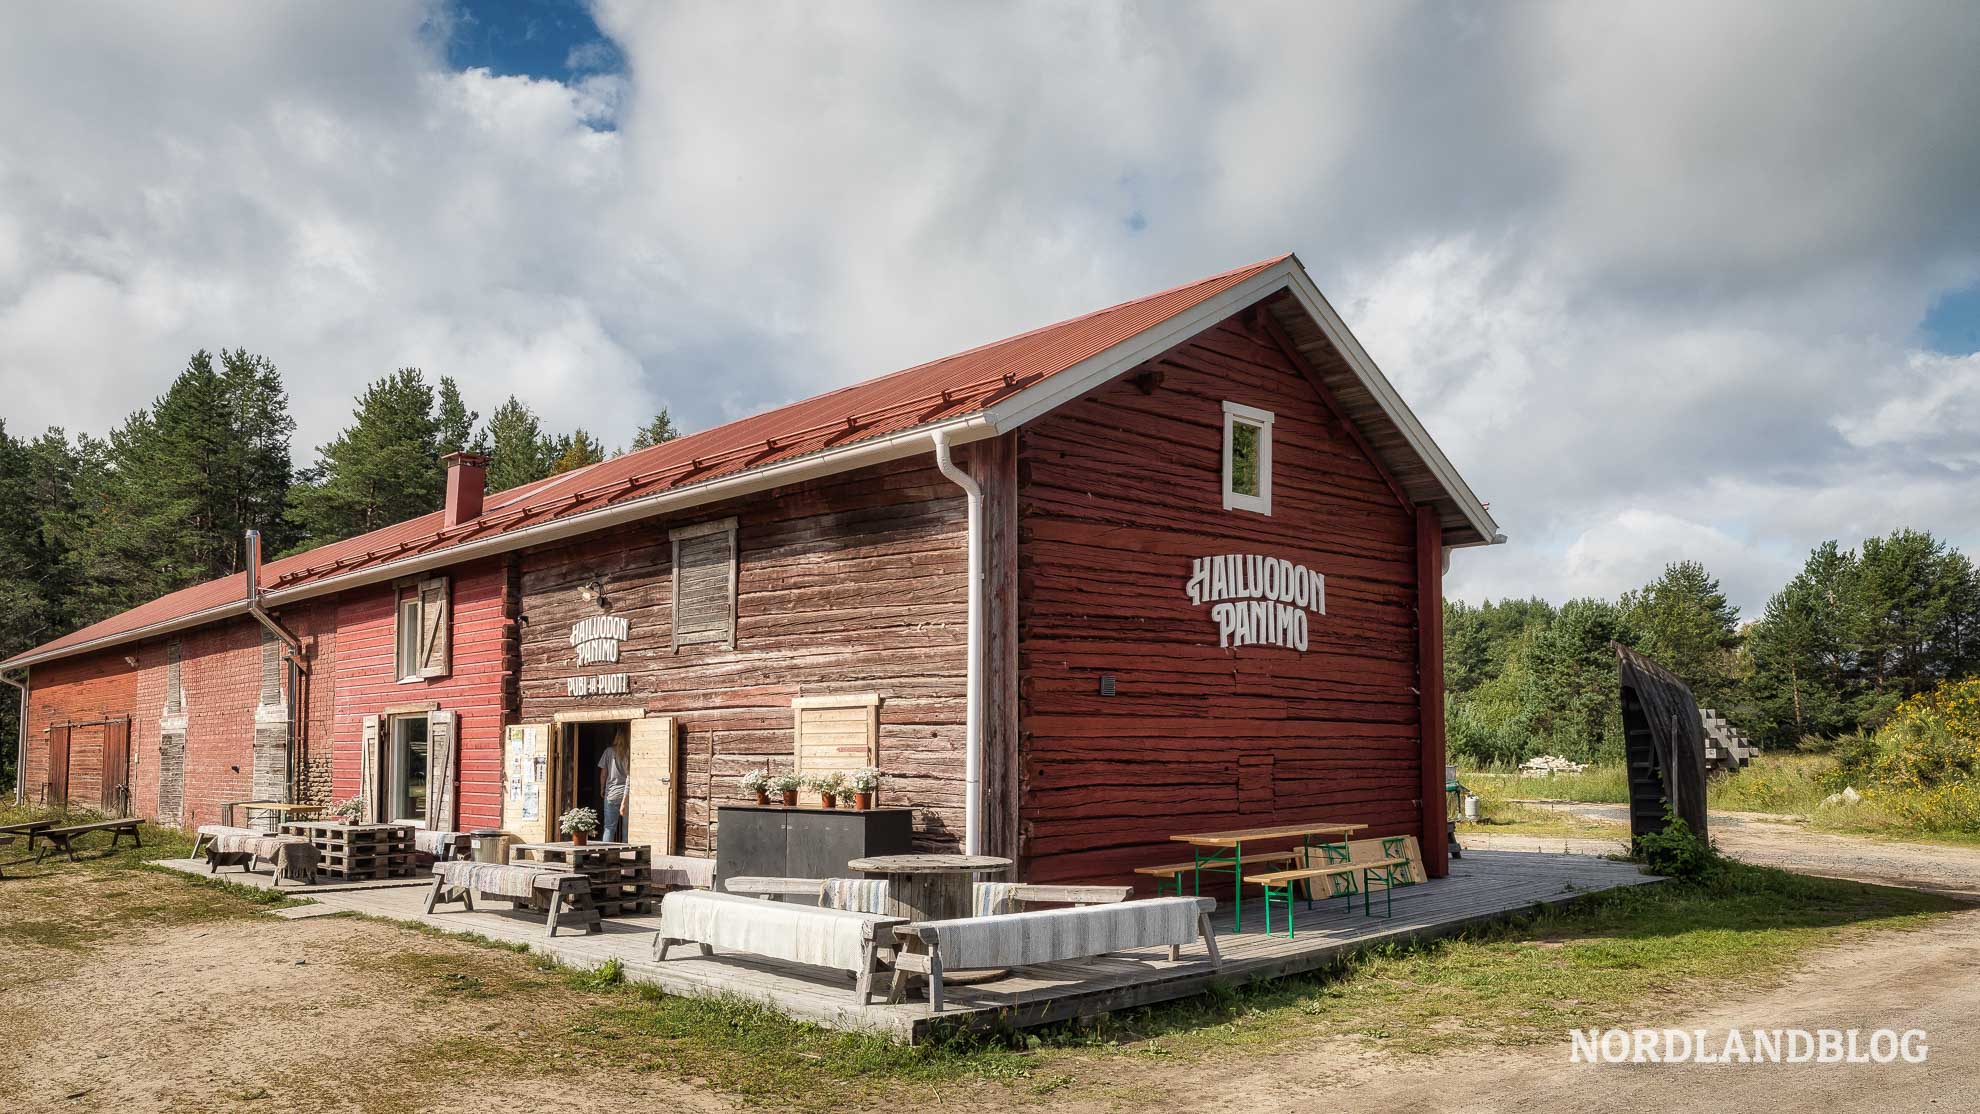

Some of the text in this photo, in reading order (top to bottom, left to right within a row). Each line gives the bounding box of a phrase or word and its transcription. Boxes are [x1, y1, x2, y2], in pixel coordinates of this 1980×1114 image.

[1186, 554, 1326, 615] HAILUODON
[570, 616, 628, 646] HAILUODON
[1212, 601, 1308, 651] PANIMO
[577, 639, 618, 666] PANIMO
[567, 676, 586, 696] PUBI
[598, 673, 627, 694] PUOTI
